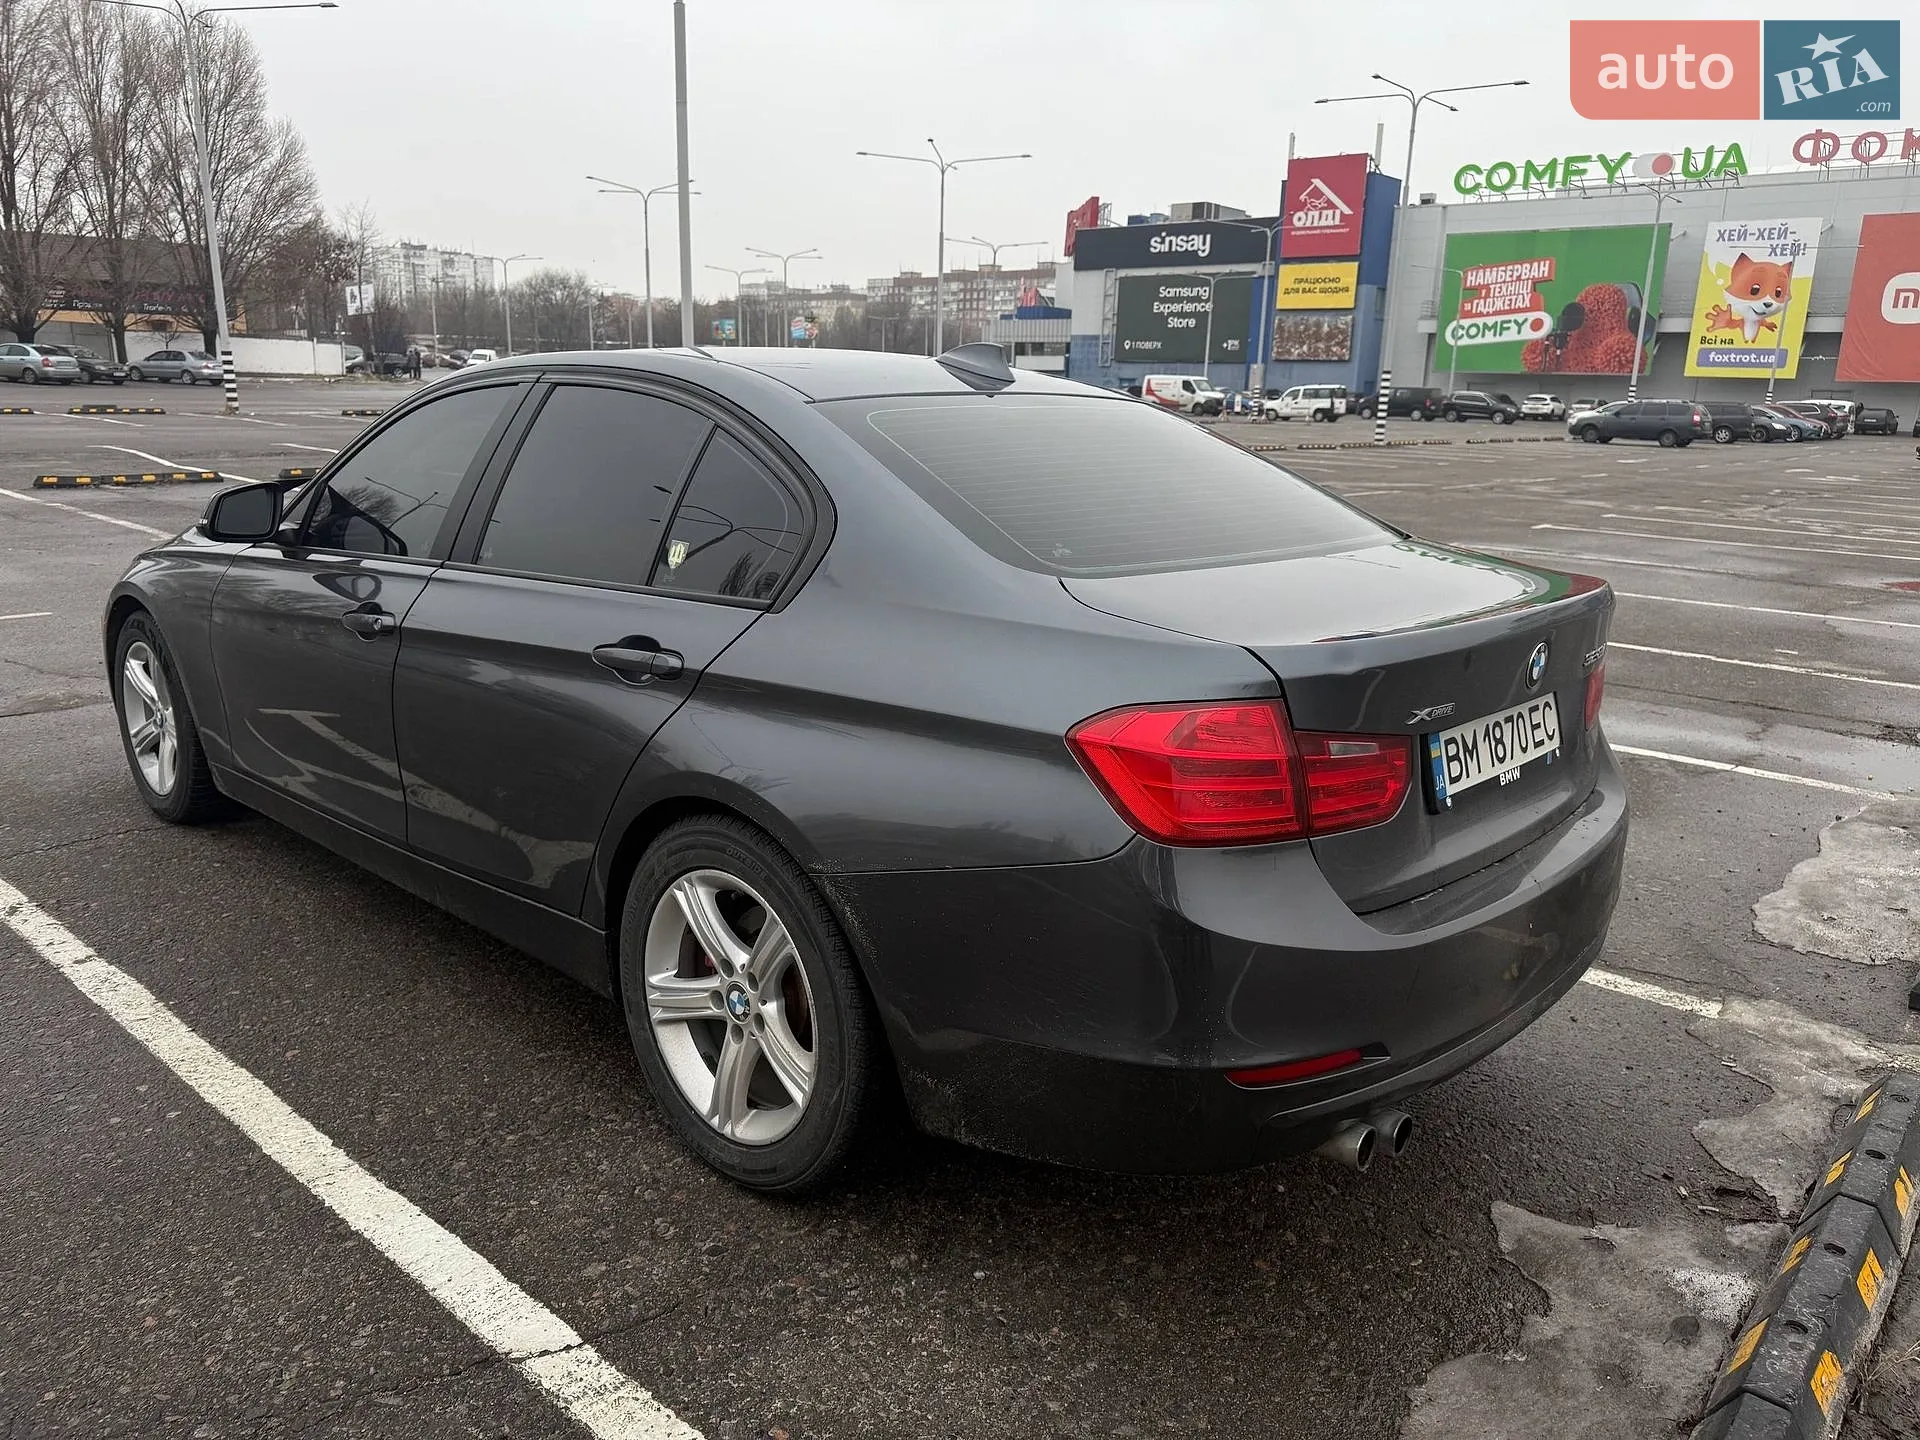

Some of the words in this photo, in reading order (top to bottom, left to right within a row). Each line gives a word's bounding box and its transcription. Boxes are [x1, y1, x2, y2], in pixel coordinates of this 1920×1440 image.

[1454, 152, 1632, 195] COMFY
[1681, 142, 1748, 179] UA
[1150, 232, 1211, 257] sinsay
[1466, 260, 1550, 287] НАМБЕРВАН
[1159, 286, 1209, 299] Samsung
[1489, 280, 1532, 298] ТЕХНІЦІ
[1153, 301, 1213, 316] Experience
[1472, 294, 1532, 315] ГАДЖЕТАХ
[1168, 316, 1196, 328] Store
[1451, 318, 1528, 340] COMFY
[1700, 335, 1717, 345] Всі
[1709, 351, 1776, 363] foxtrot.ua
[1443, 728, 1482, 785] BM
[1483, 711, 1529, 768] 1870
[1528, 701, 1556, 750] EC
[1499, 766, 1521, 786] BMW
